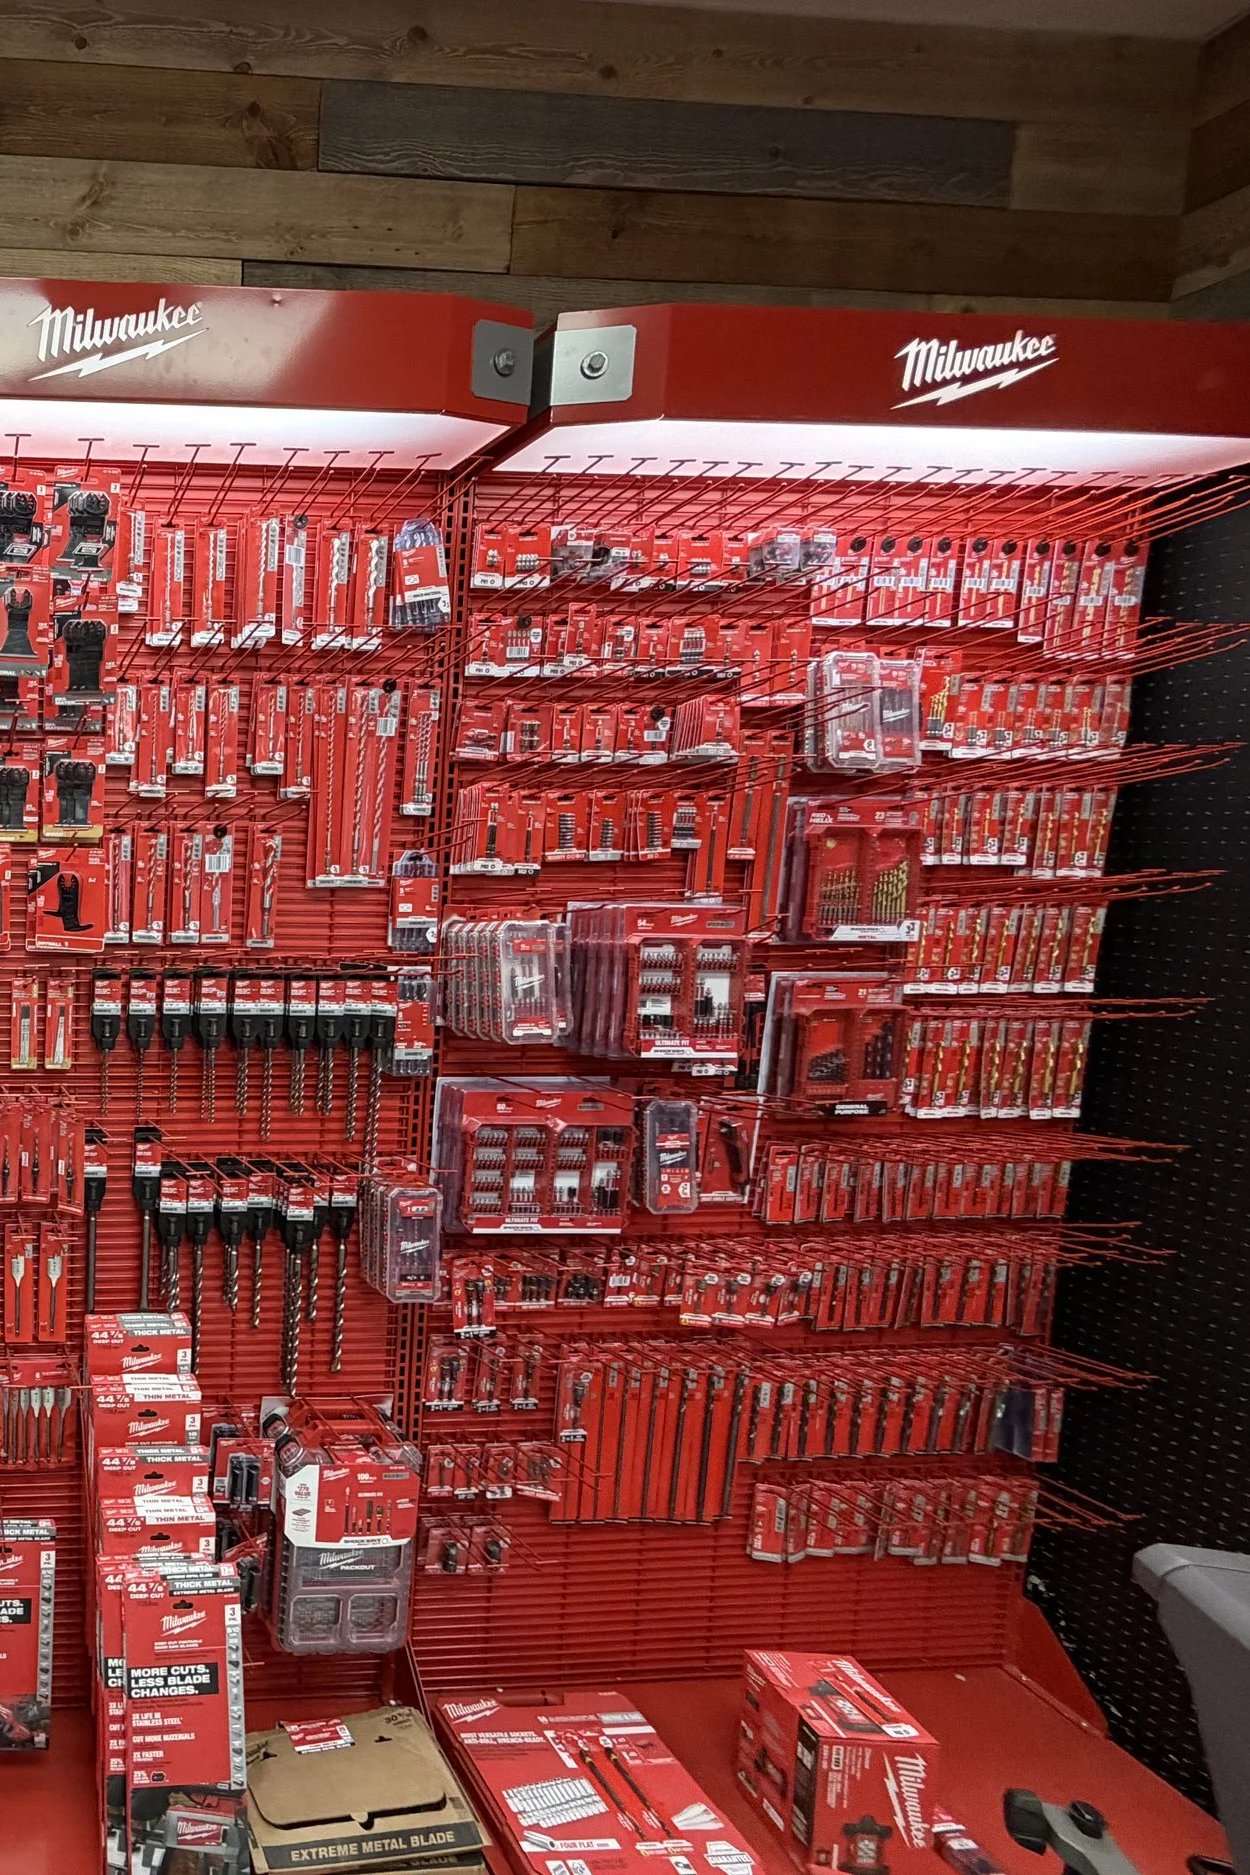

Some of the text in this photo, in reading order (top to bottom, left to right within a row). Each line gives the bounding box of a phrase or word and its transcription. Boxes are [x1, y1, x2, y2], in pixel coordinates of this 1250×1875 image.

[28, 298, 203, 362] Milwaukee
[894, 330, 1056, 391] Milwaukee
[120, 1353, 162, 1368] Milwaukee
[96, 1395, 115, 1403] 44
[127, 1418, 170, 1433] Milwaukee
[190, 1416, 196, 1424] 3
[133, 1481, 177, 1495] Milwaukee
[107, 1518, 125, 1526] 44
[138, 1542, 183, 1554] Milwaukee
[204, 1539, 210, 1547] 3
[44, 1553, 51, 1561] 3
[318, 1550, 364, 1565] Milwaukee
[128, 1584, 148, 1592] 44
[229, 1607, 236, 1616] 3
[160, 1611, 207, 1631] Milwaukee
[131, 1665, 209, 1677] MORE CUTS.
[131, 1677, 165, 1688] LESS
[167, 1675, 211, 1685] BLADE
[831, 1657, 901, 1713] Milwaukee
[131, 1686, 199, 1698] CHANGES.
[442, 1698, 499, 1719] Milwaukee
[132, 1719, 162, 1727] STAINLESS
[145, 1734, 162, 1742] MORE
[163, 1733, 195, 1741] MATERIALS
[895, 1752, 930, 1849] Milwaukee
[177, 1821, 218, 1834] Milwaukee
[291, 1831, 456, 1862] EXTREME METAL BLADE
